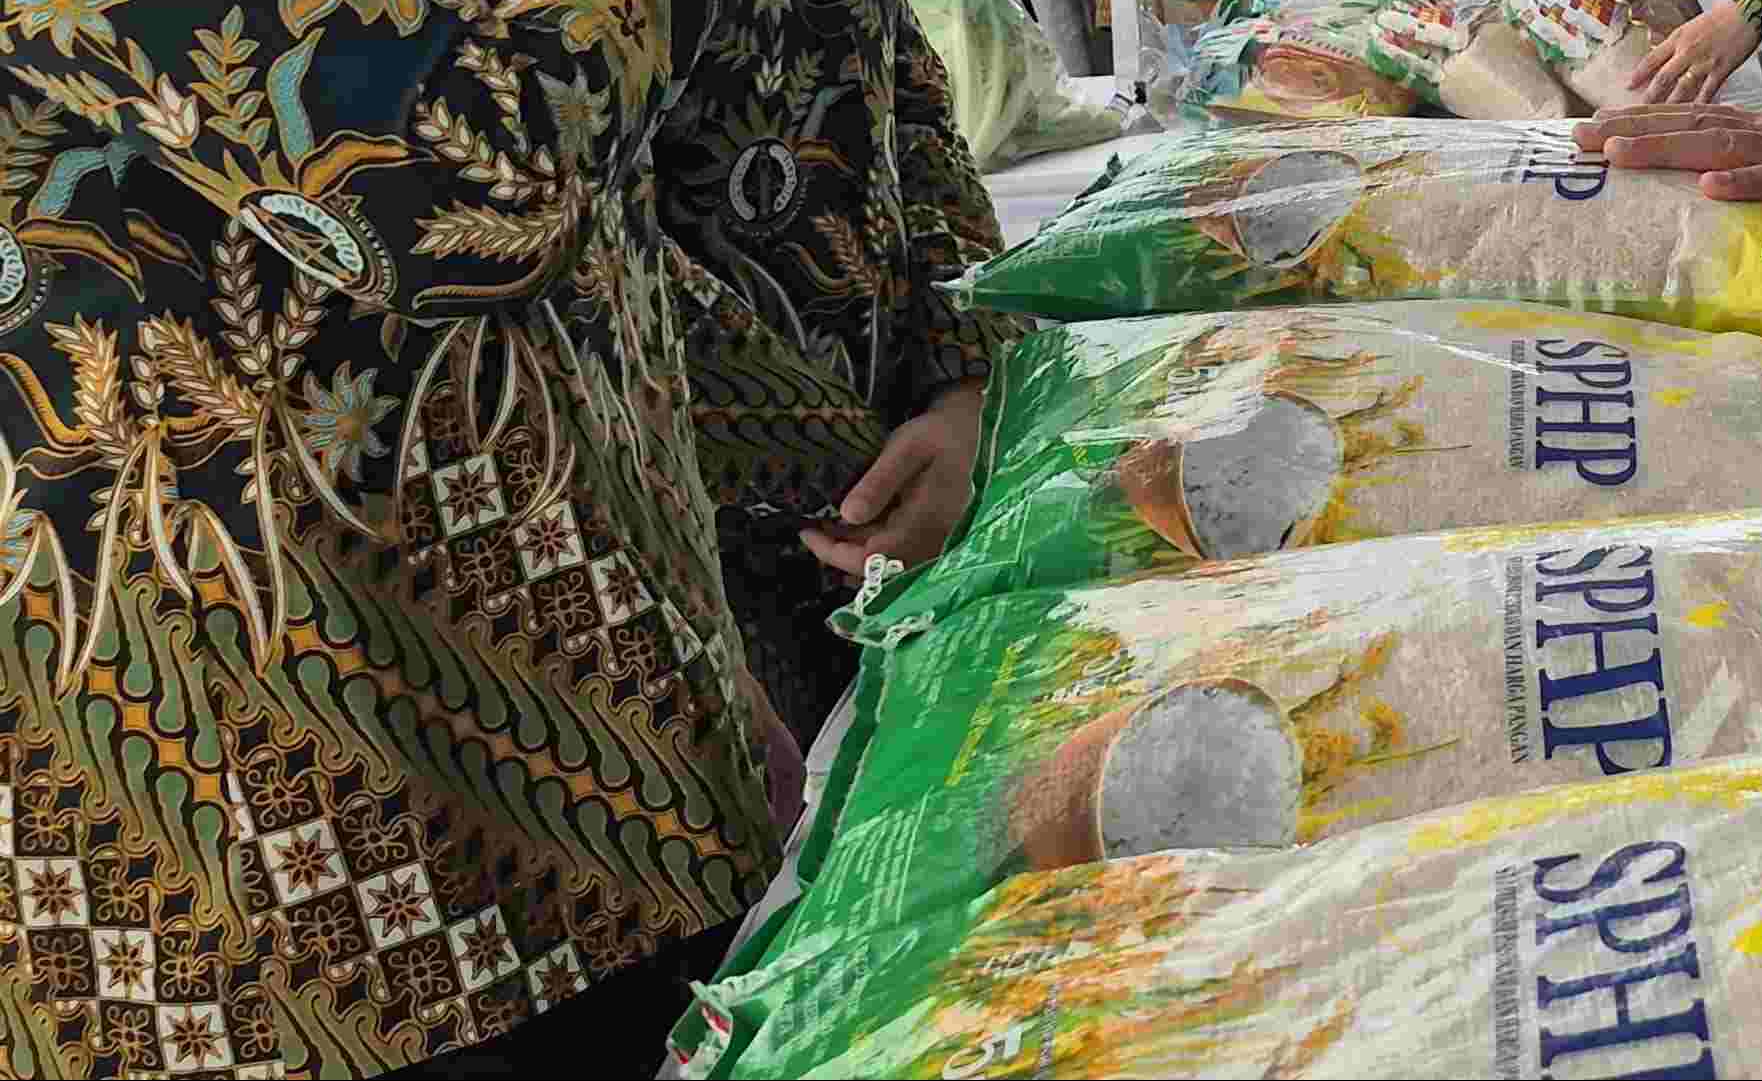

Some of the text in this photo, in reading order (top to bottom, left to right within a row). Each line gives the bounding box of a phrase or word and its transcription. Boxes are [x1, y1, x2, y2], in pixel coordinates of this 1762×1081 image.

[1535, 338, 1638, 487] SPHP
[1503, 654, 1526, 701] HARGA
[1535, 544, 1673, 776] SPHP
[1508, 703, 1529, 765] PANGAN
